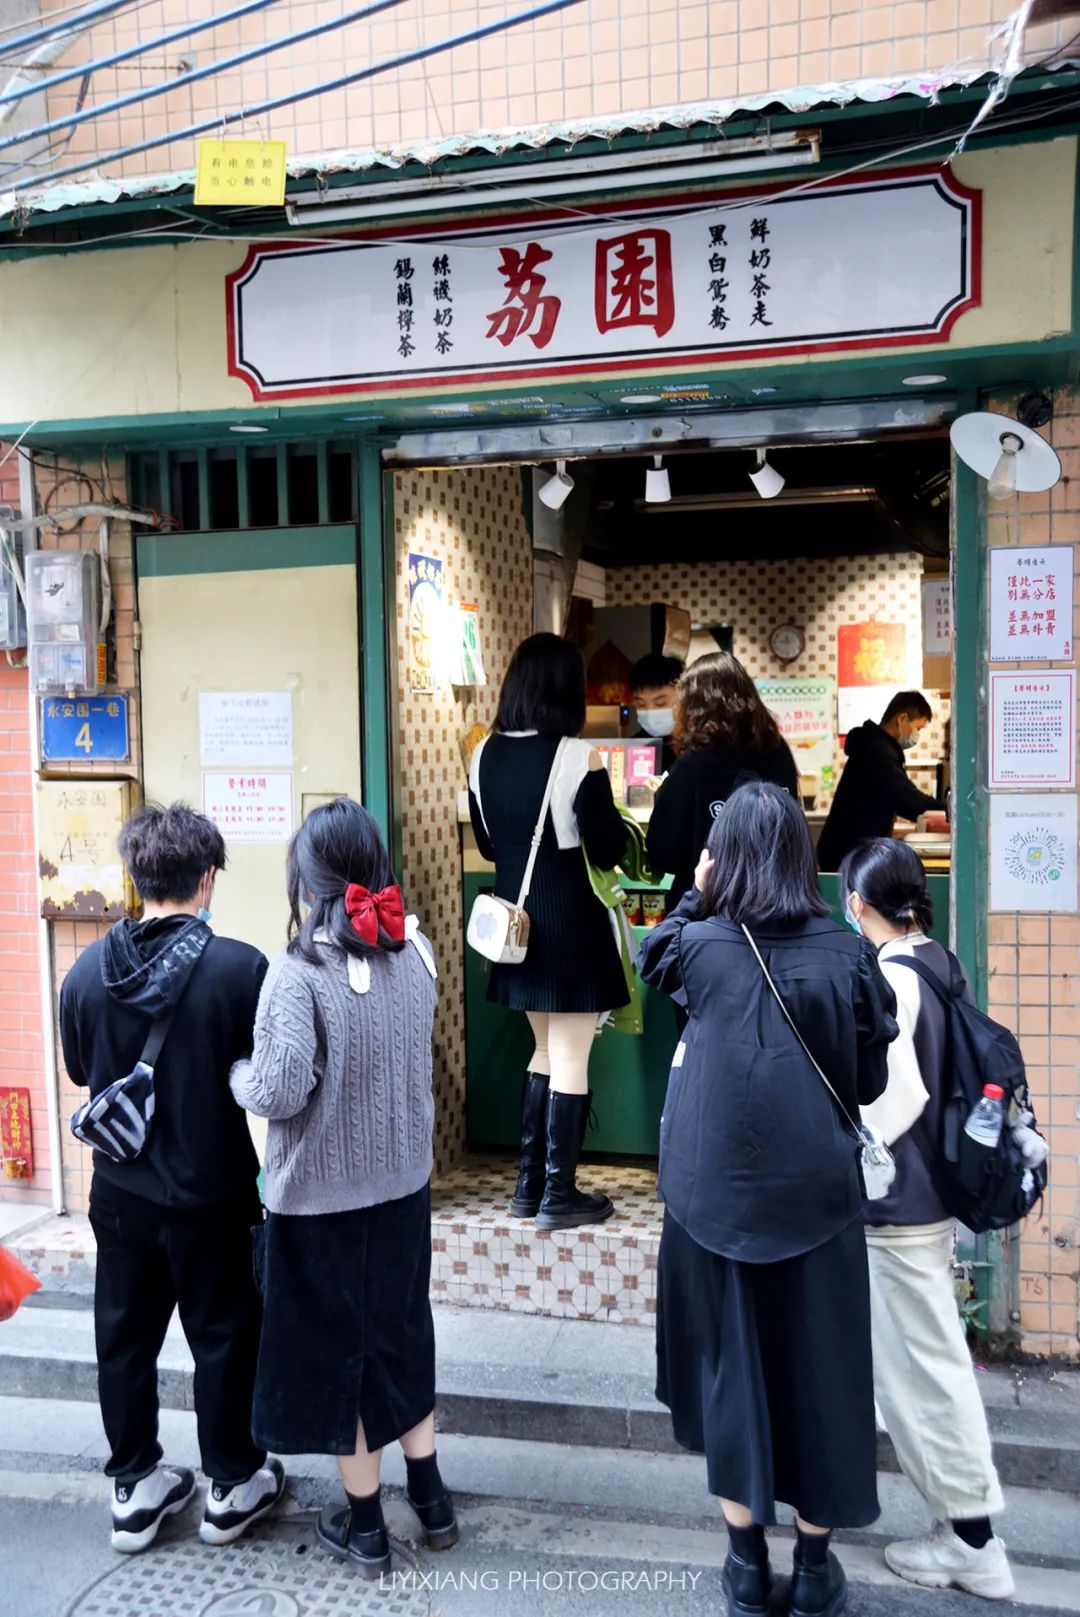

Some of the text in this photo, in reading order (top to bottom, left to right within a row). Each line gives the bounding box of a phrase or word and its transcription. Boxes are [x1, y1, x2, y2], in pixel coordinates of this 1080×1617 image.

[211, 175, 271, 187] 当心触电
[212, 158, 273, 169] 有电危险
[432, 253, 454, 355] 絲襪奶茶
[485, 228, 676, 350] 荔園
[706, 224, 731, 331] 黑白鴛鴦
[748, 217, 774, 328] 鮮奶茶走
[393, 257, 417, 358] 錫蘭檸茶
[1007, 574, 1056, 588] 僅此一家
[1007, 587, 1056, 601] 別無分店
[74, 721, 94, 753] 4
